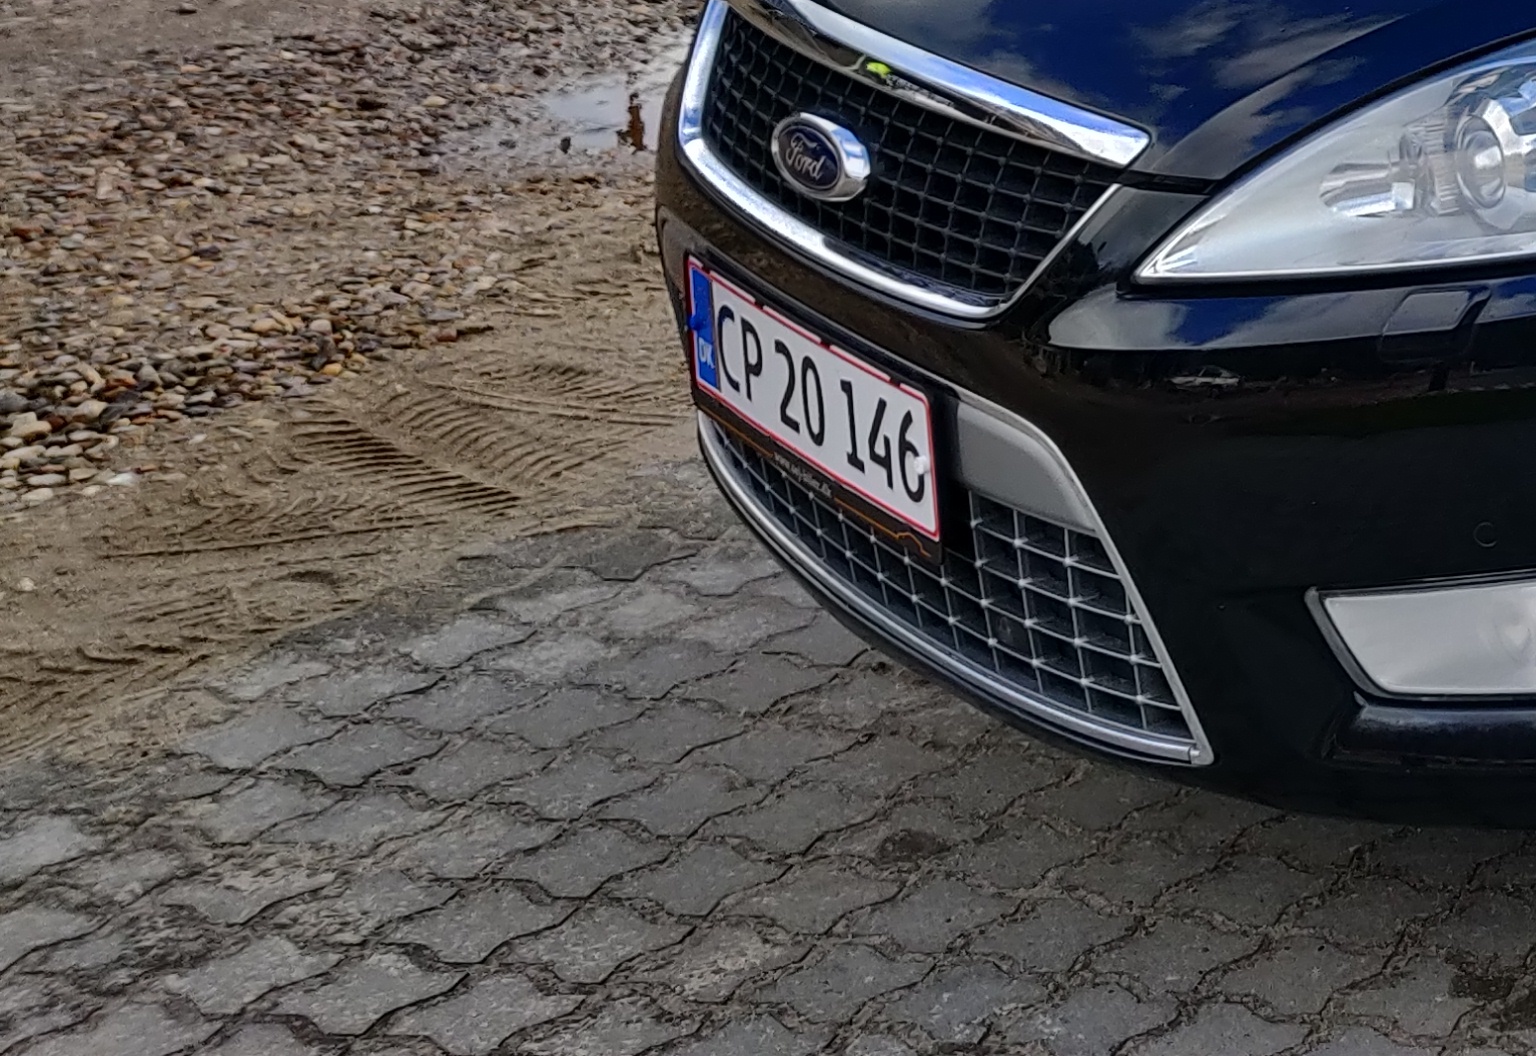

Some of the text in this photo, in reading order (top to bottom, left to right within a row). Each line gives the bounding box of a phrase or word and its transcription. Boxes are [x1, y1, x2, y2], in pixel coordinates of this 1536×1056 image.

[785, 132, 827, 181] Ford
[698, 336, 716, 370] DK
[717, 304, 762, 403] CP
[774, 338, 826, 446] 20
[839, 378, 926, 504] 146
